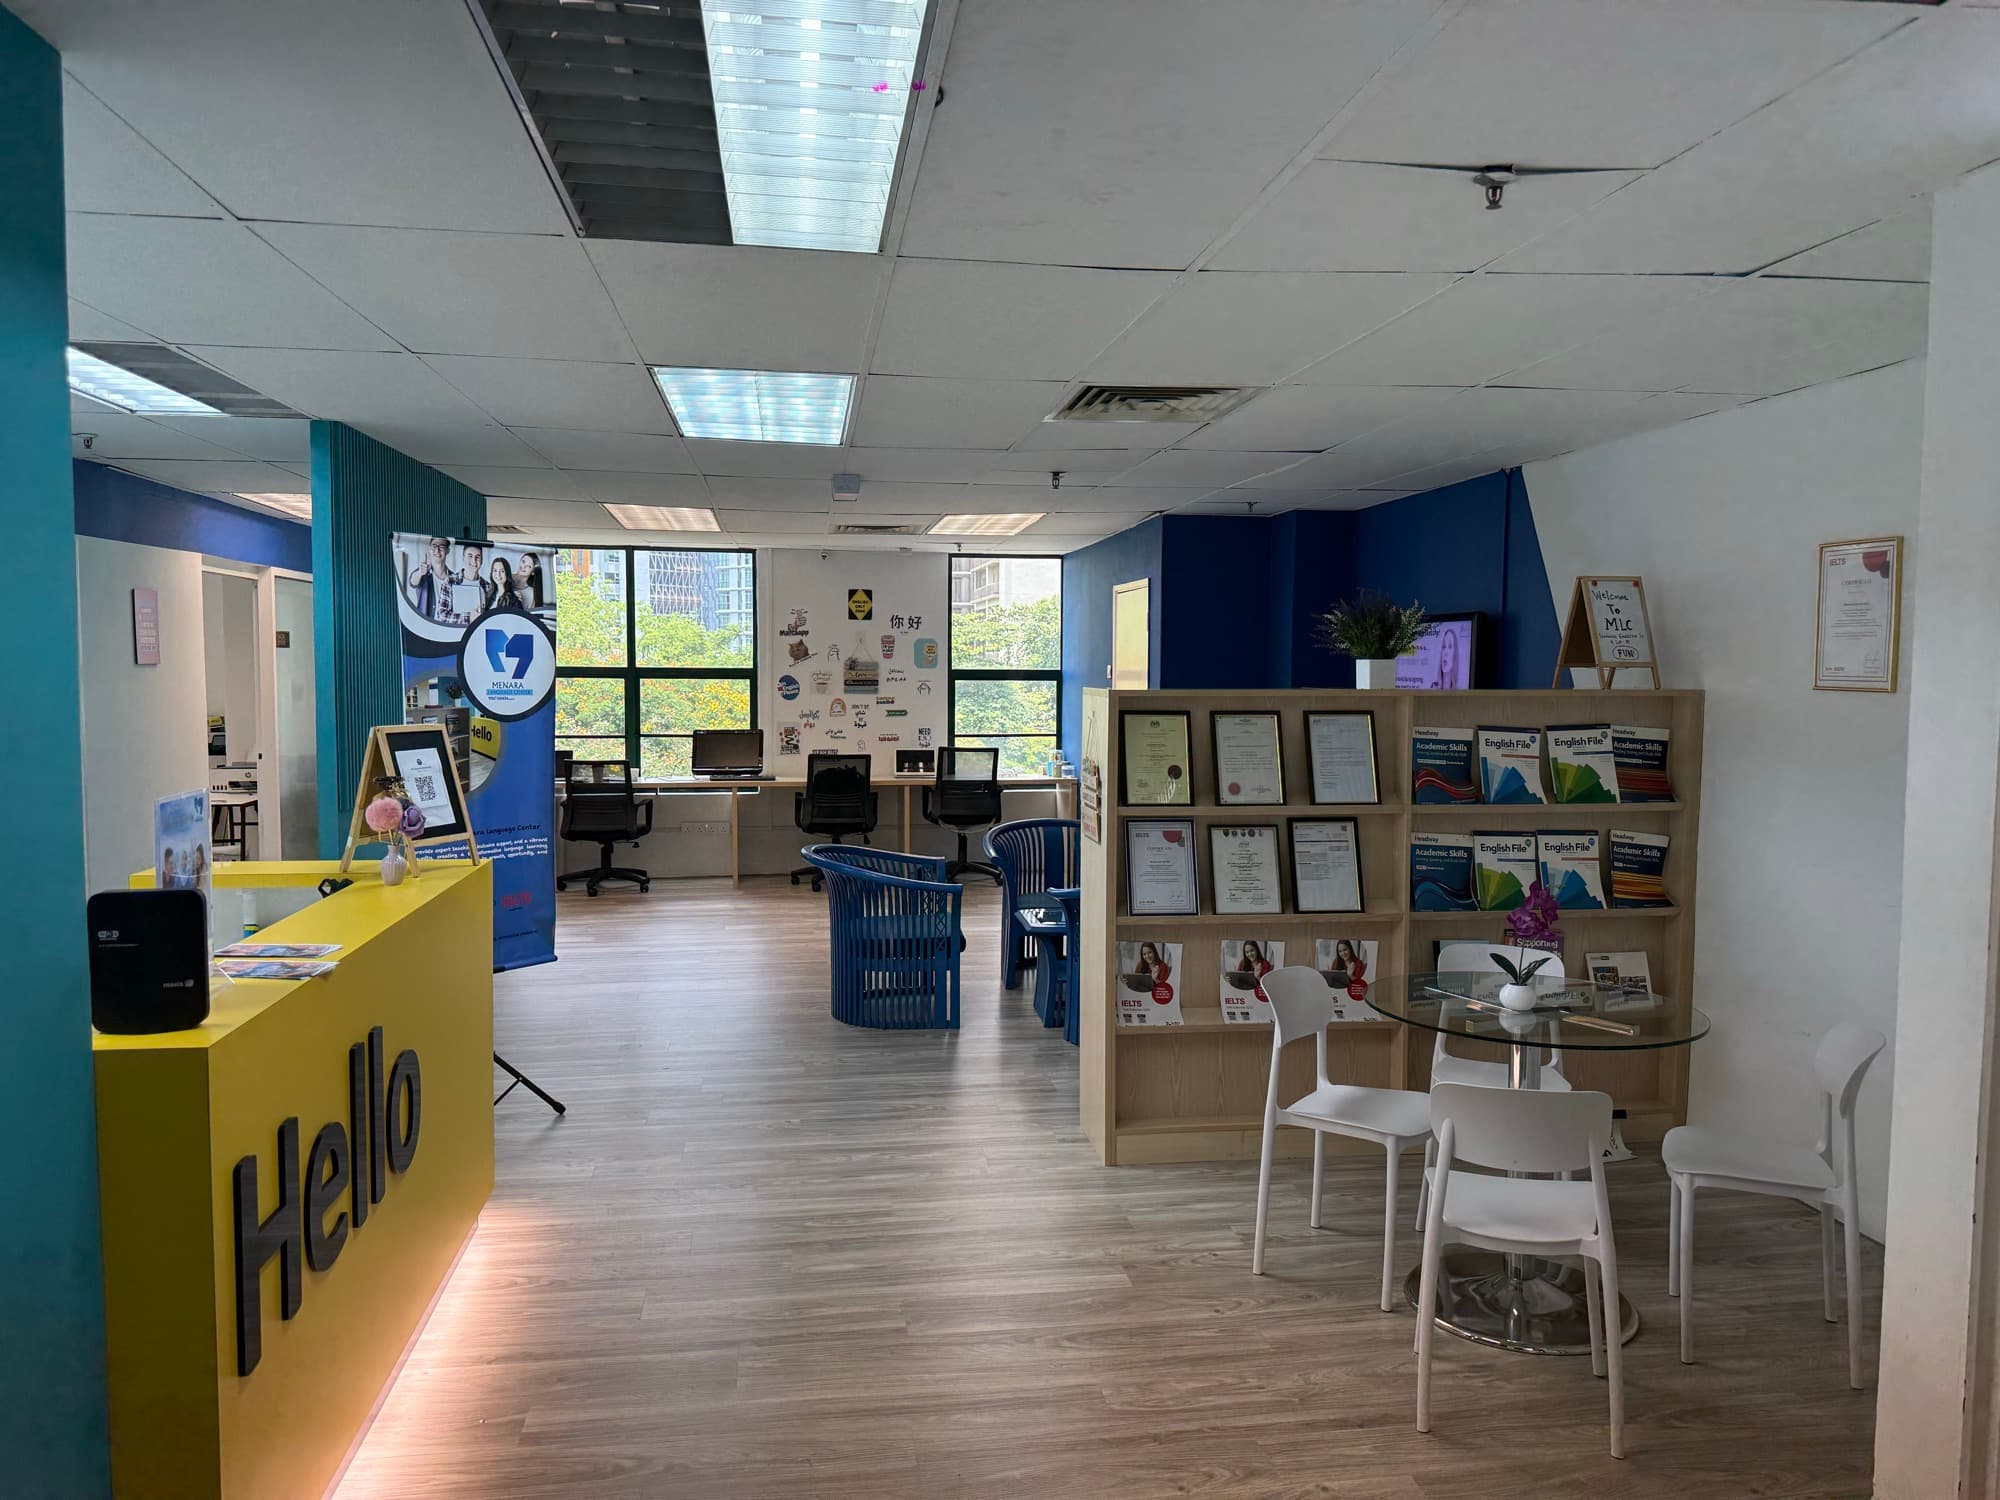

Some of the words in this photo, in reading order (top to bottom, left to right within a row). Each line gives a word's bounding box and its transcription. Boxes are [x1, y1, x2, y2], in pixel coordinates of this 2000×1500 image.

[1829, 557, 1847, 567] IELTS
[1591, 590, 1629, 601] Welcome
[1606, 604, 1621, 615] To
[890, 614, 922, 630] 你好
[1604, 617, 1633, 631] MLC
[492, 681, 524, 689] MENARA
[1416, 742, 1449, 751] Academic
[1449, 743, 1468, 752] Skills
[1485, 738, 1515, 750] English
[1516, 740, 1531, 749] File
[1554, 737, 1586, 749] English
[1587, 736, 1604, 745] File
[1614, 740, 1645, 750] Academic
[1645, 742, 1663, 752] Skills
[487, 826, 516, 835] Language
[1415, 835, 1439, 843] Headway
[1612, 832, 1635, 842] Headway
[1415, 848, 1449, 857] Academic
[1449, 849, 1468, 858] Skills
[1480, 842, 1510, 854] English
[1512, 843, 1527, 852] File
[1544, 842, 1574, 853] English
[1575, 842, 1590, 852] File
[1613, 845, 1642, 855] Academic
[1643, 848, 1661, 857] Skills
[1121, 999, 1143, 1007] IELTS
[1225, 997, 1246, 1005] IELTS
[231, 1025, 422, 1377] Hello
